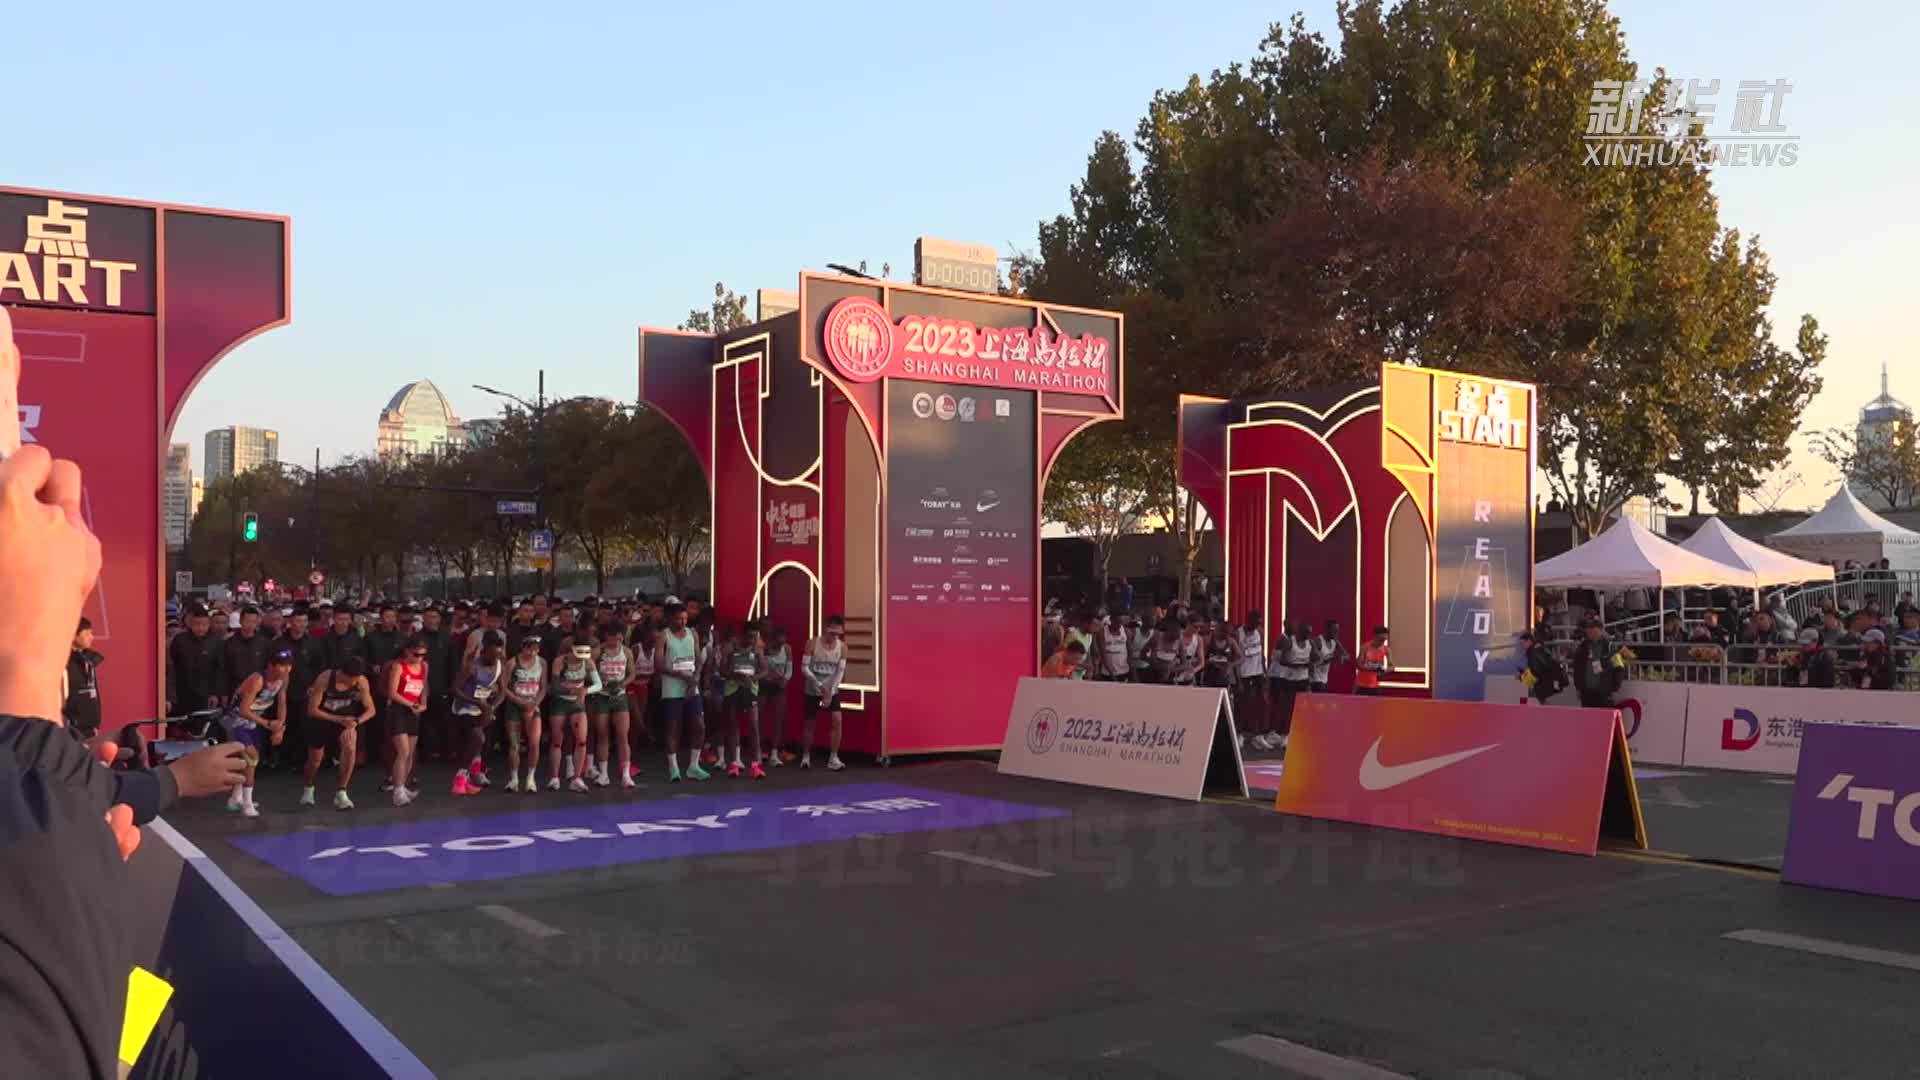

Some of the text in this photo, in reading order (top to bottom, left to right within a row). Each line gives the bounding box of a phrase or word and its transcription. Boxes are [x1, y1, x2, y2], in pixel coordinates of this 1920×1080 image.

[24, 199, 89, 259] 点
[904, 359, 1107, 391] SHANGHAI MARATHON
[1438, 408, 1526, 448] START
[1472, 501, 1492, 673] READY
[1059, 742, 1181, 766] SHANGHAI MARATHON
